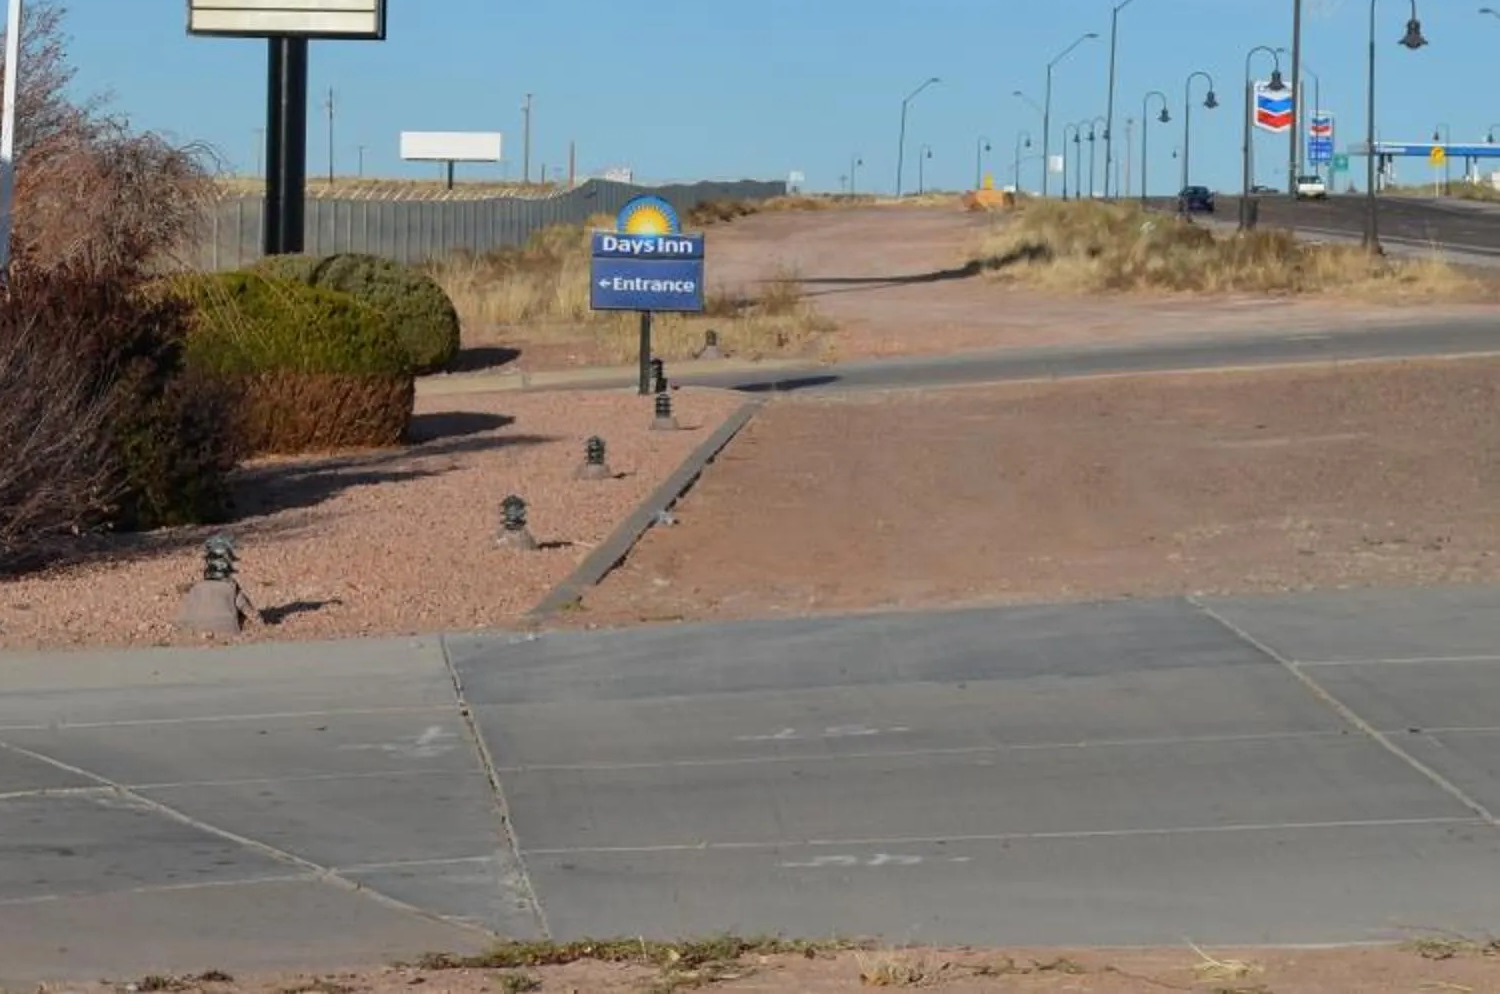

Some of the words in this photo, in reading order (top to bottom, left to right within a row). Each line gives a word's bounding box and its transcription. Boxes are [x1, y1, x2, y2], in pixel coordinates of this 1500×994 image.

[602, 236, 655, 254] Days
[658, 237, 693, 253] Inn
[613, 278, 695, 292] Entrance
